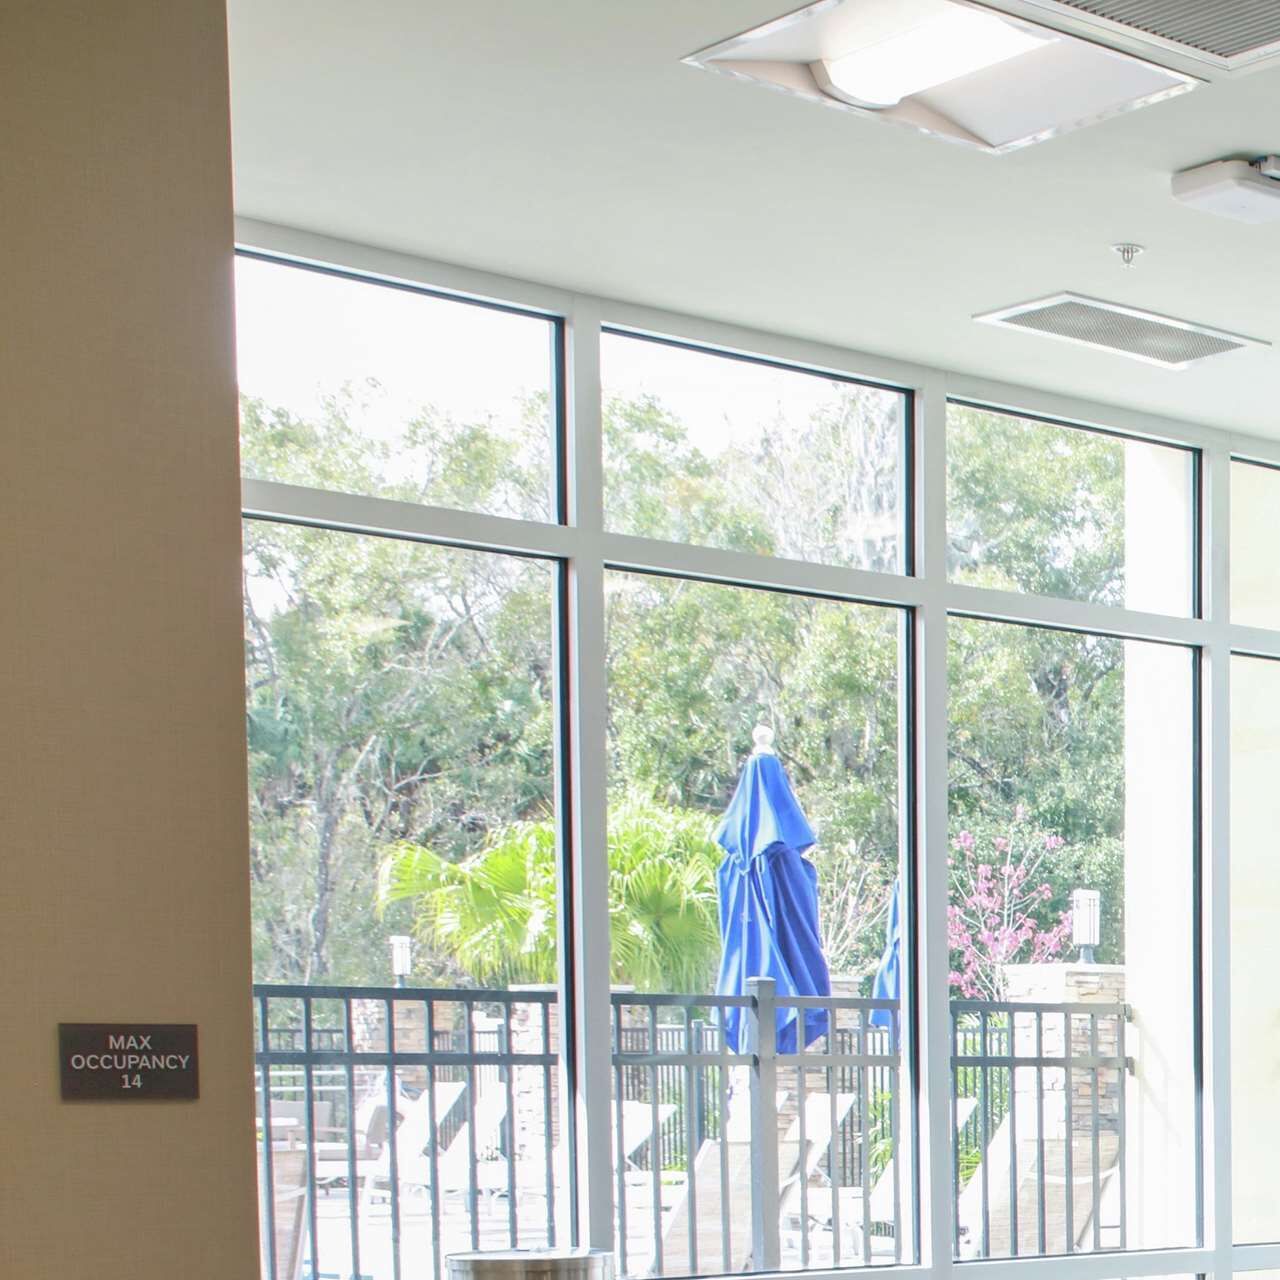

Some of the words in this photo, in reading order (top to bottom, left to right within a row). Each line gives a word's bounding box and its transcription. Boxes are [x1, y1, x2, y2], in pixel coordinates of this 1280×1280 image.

[108, 1034, 152, 1050] MAX
[71, 1054, 190, 1070] OCCUPANCY
[121, 1074, 143, 1089] 14
